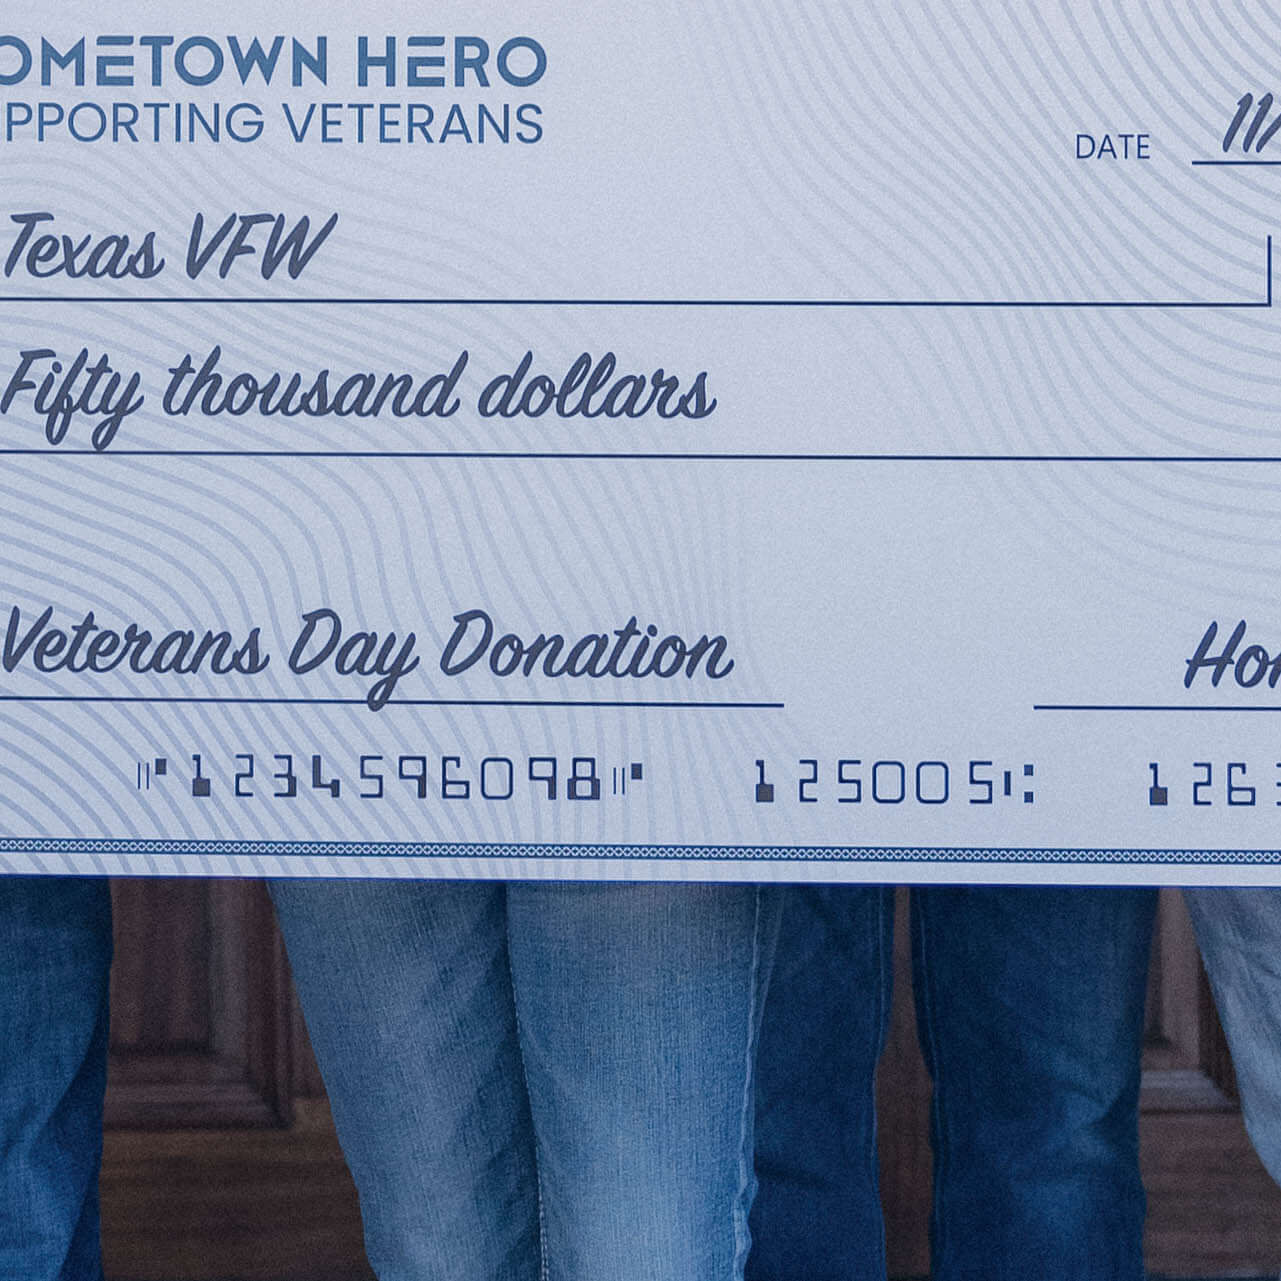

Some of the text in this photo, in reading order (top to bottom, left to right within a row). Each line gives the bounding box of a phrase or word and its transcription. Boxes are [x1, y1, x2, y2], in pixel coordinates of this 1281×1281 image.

[356, 34, 549, 89] HERO
[280, 101, 544, 145] VETERANS
[1075, 132, 1151, 161] DATE
[3, 211, 340, 282] Texas VFW
[161, 344, 468, 419] thousand
[476, 349, 719, 421] dollars
[1, 604, 736, 713] Veterans Day Donation
